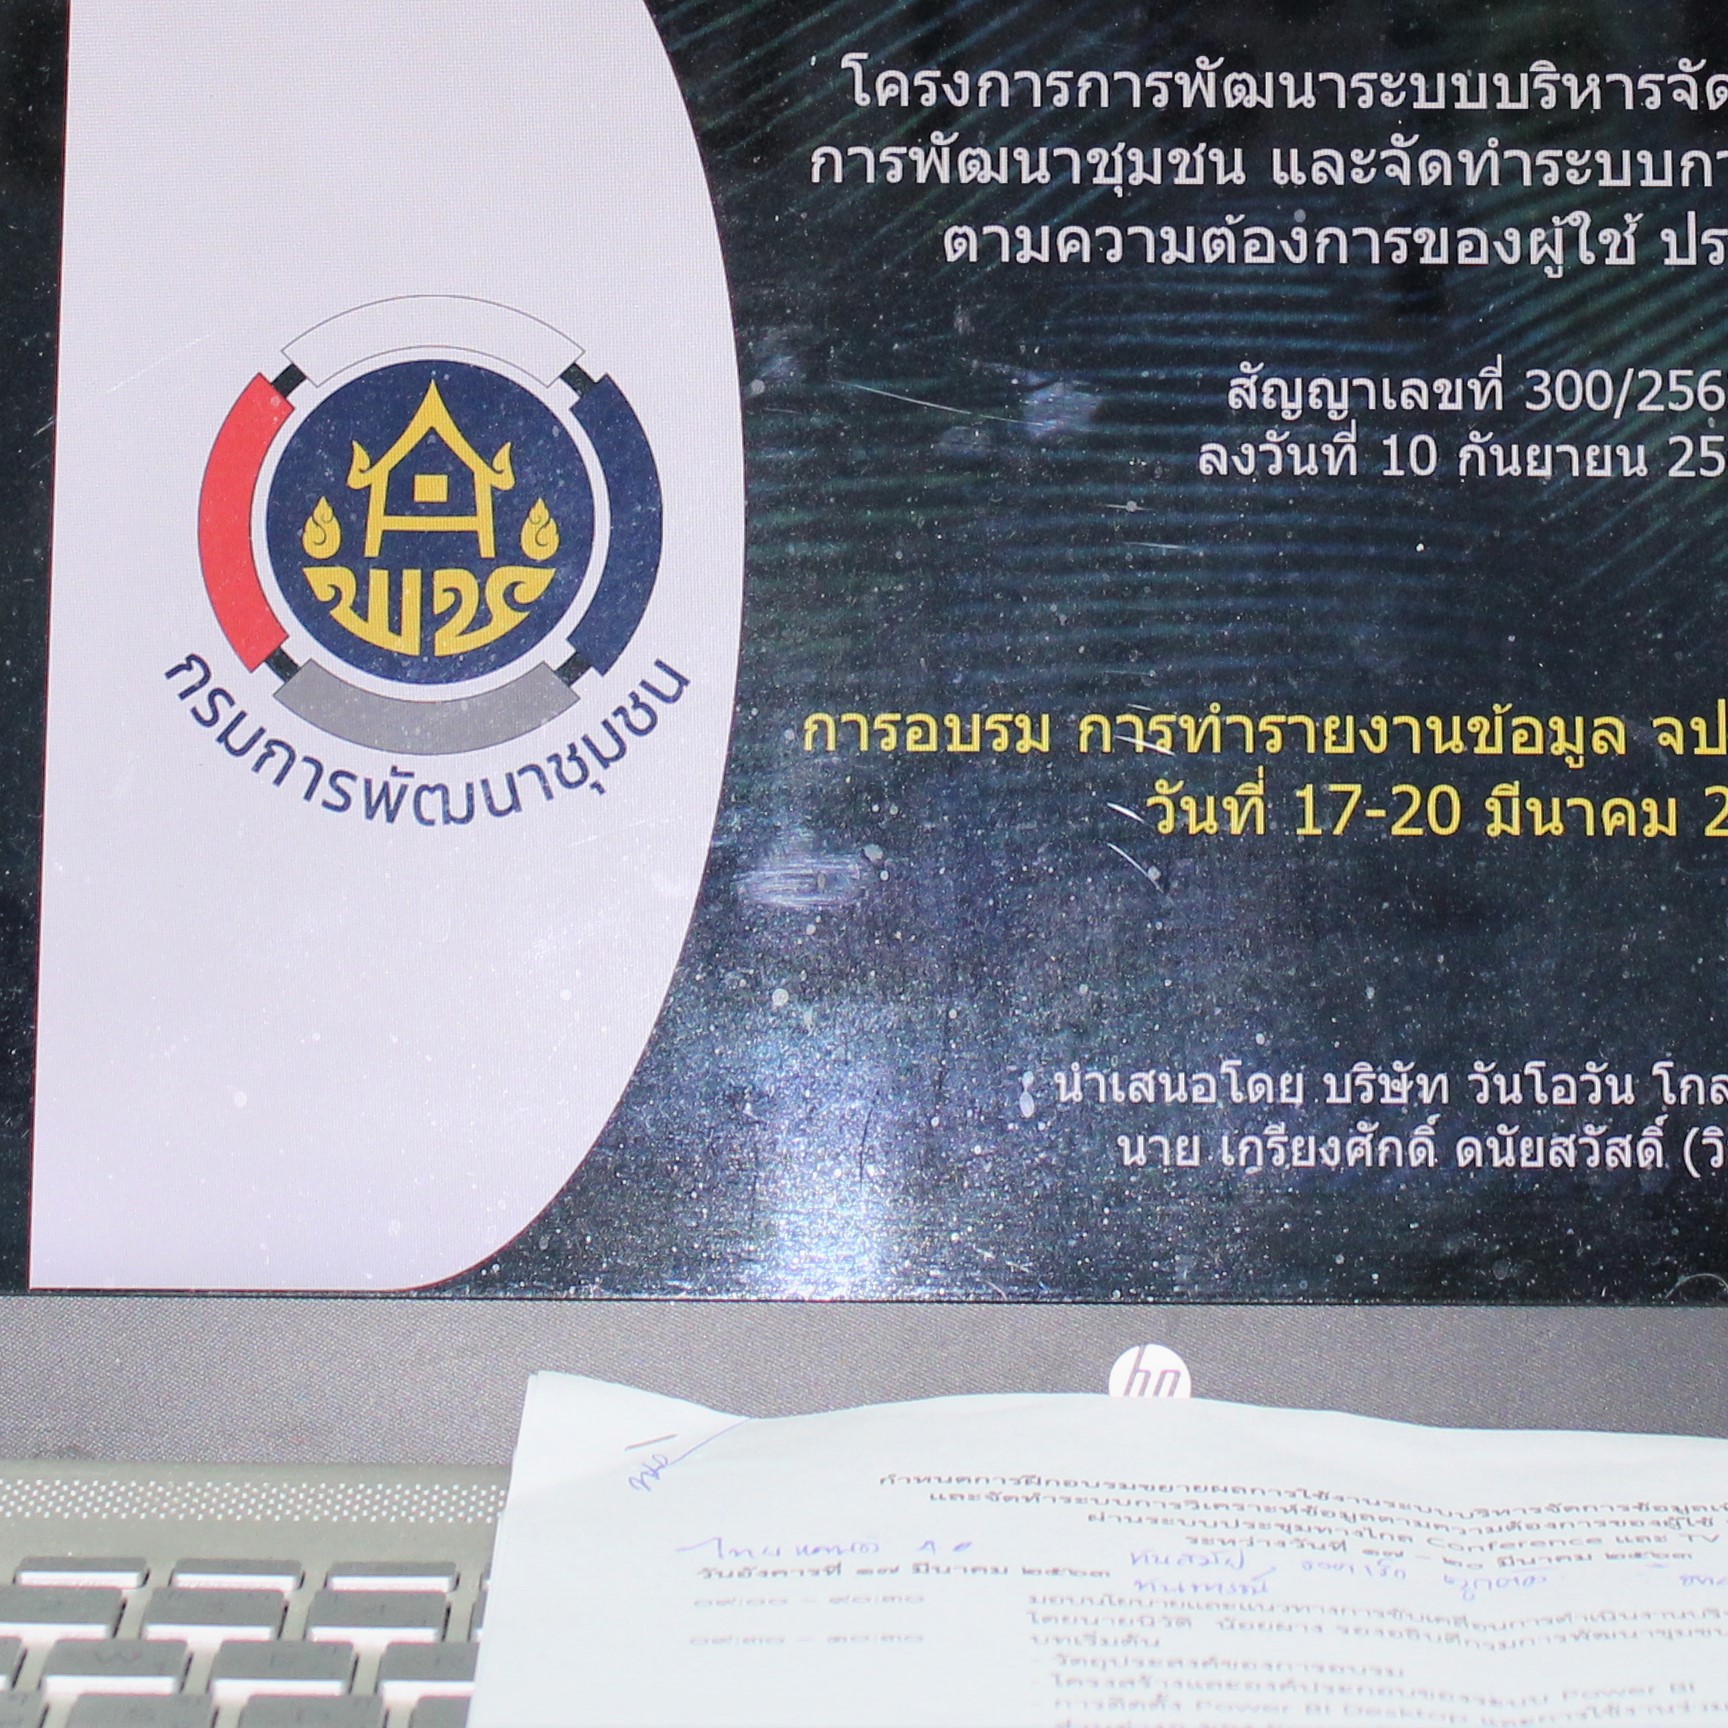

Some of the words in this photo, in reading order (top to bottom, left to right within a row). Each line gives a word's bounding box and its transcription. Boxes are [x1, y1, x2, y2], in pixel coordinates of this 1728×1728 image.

[811, 132, 1246, 191] การพัฒนาชุมชน
[944, 209, 1643, 278] ตามความต้องการของผู้ใช้
[1228, 355, 1502, 421] สัญญาเลขที่
[1198, 418, 1357, 475] ลงวันที่
[1383, 434, 1437, 476] 10
[1459, 430, 1648, 480] กันยายน
[164, 648, 691, 827] กรมการพัฒนาชุมชน
[801, 706, 1051, 756] การอบรม
[1079, 702, 1626, 776] การทำรายงานข้อมูล
[1146, 767, 1264, 835] วันที่
[1294, 784, 1461, 838] 17-20
[1485, 780, 1676, 838] มีนาคม
[1052, 1059, 1305, 1108] นำเสนอโดย
[1323, 1060, 1448, 1104] บริษัท
[1468, 1060, 1634, 1104] วันโอวัน
[1117, 1129, 1199, 1168] นาย
[1216, 1110, 1440, 1175] เกรียงศักดิ์
[1456, 1114, 1666, 1169] ดนัยสวัสดิ์
[1425, 1536, 1603, 1553] Conference
